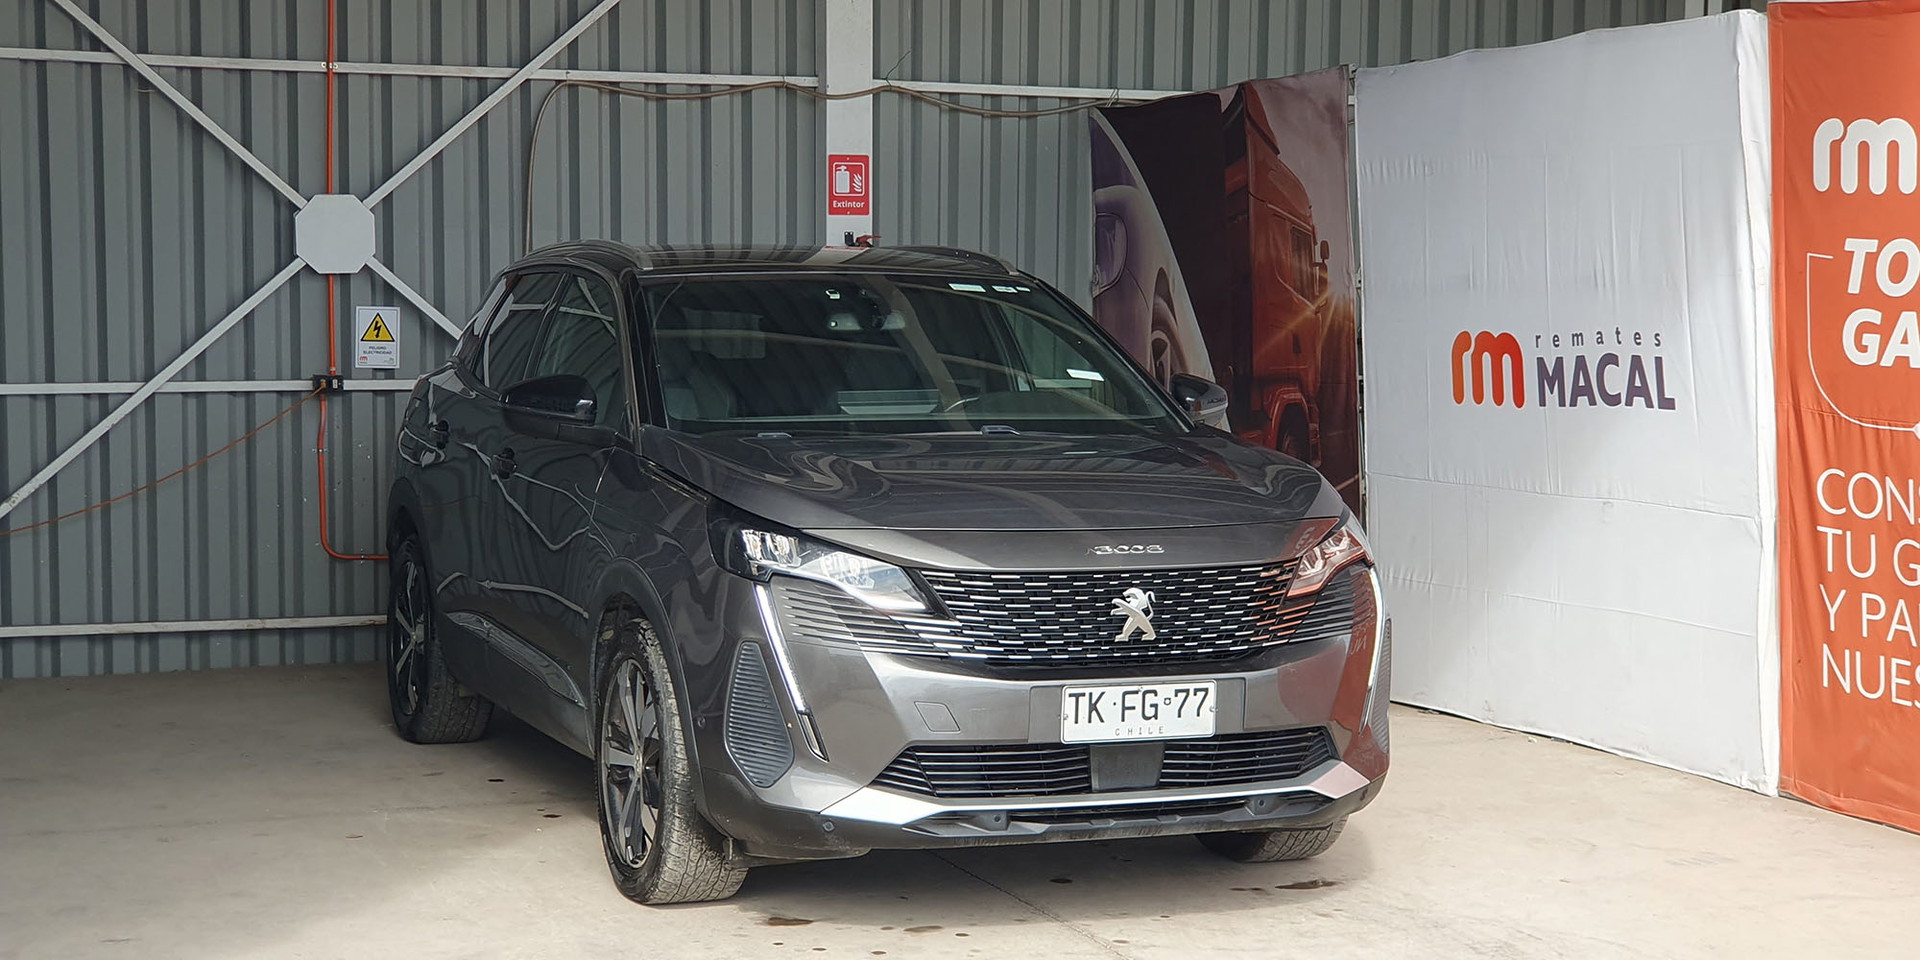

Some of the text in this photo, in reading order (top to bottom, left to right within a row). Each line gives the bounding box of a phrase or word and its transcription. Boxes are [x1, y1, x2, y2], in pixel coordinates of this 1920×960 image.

[1813, 118, 1918, 195] rm
[833, 200, 865, 208] Extintor
[1535, 327, 1661, 348] remates
[1451, 330, 1525, 408] rm
[1536, 353, 1676, 410] MACAL
[1816, 468, 1920, 525] CON
[1817, 525, 1876, 578] TU
[1819, 584, 1920, 648] Y PA
[1115, 726, 1164, 736] CHILE
